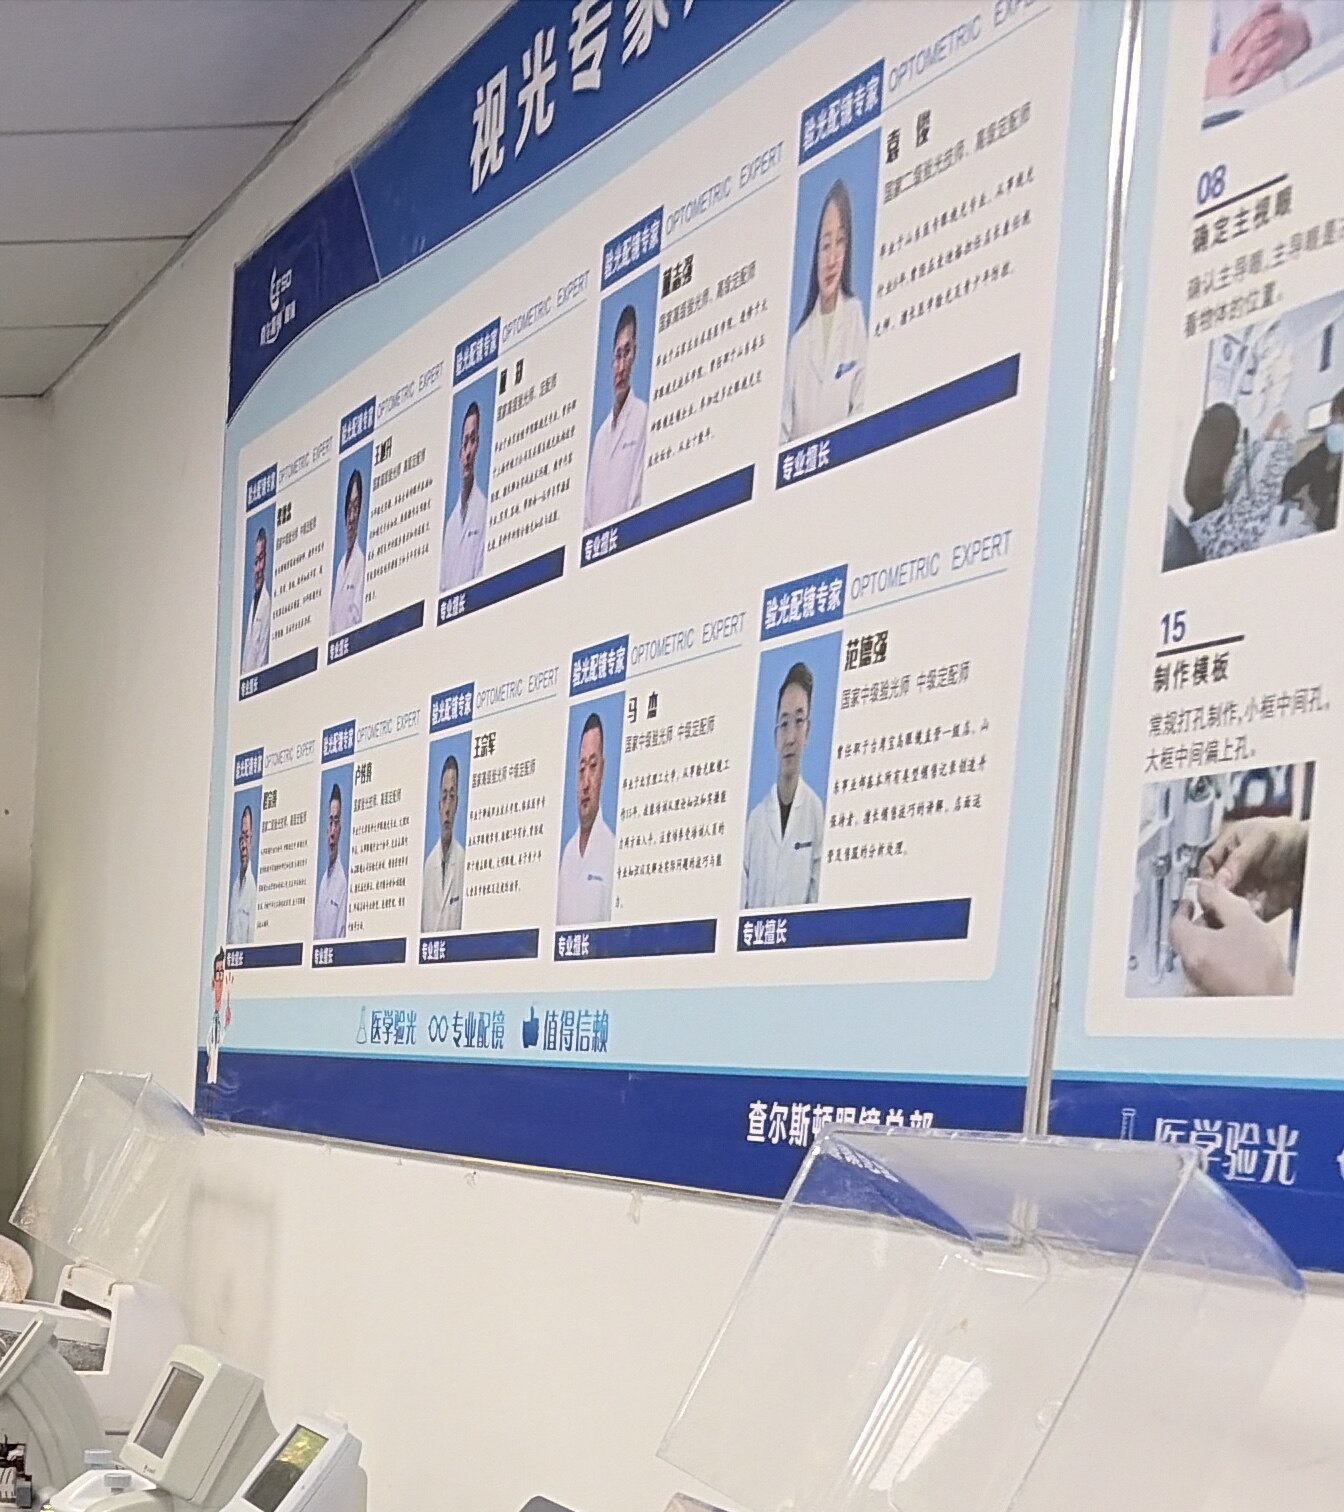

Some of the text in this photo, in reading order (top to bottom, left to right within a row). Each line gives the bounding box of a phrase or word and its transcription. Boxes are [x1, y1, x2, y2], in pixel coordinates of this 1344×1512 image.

[469, 0, 694, 194] 视光专家
[801, 73, 880, 154] 验光配镜专家
[888, 14, 982, 94] OPTOMETRIC
[1197, 164, 1227, 206] 08
[602, 140, 786, 283] 验光配镜专家 OPTOMETRIC EXPERT
[454, 325, 500, 381] 验光配镜专家
[557, 270, 590, 308] EXPERT
[782, 441, 831, 483] 专业擅长
[584, 529, 618, 567] 专业擅长
[765, 530, 1013, 629] 验光配镜专家 OPTOMETRIC EXPERT
[438, 595, 467, 624] 专业擅长
[1161, 609, 1187, 645] 15
[571, 611, 746, 689] 验光配镜专家 OPTOMETRIC EXPERT
[843, 630, 890, 672] 范德强
[1152, 650, 1231, 694] 制作模板
[430, 666, 559, 728] 验光配镜专家 OPTOMETRIC EXPERT
[840, 660, 970, 711] 国家中级验光师 中级定配师
[419, 939, 447, 961] 专业擅长
[557, 934, 590, 957] 专业擅长
[742, 919, 788, 946] 专业擅长
[369, 1008, 610, 1054] 医学验光 专业配镜 值得信赖
